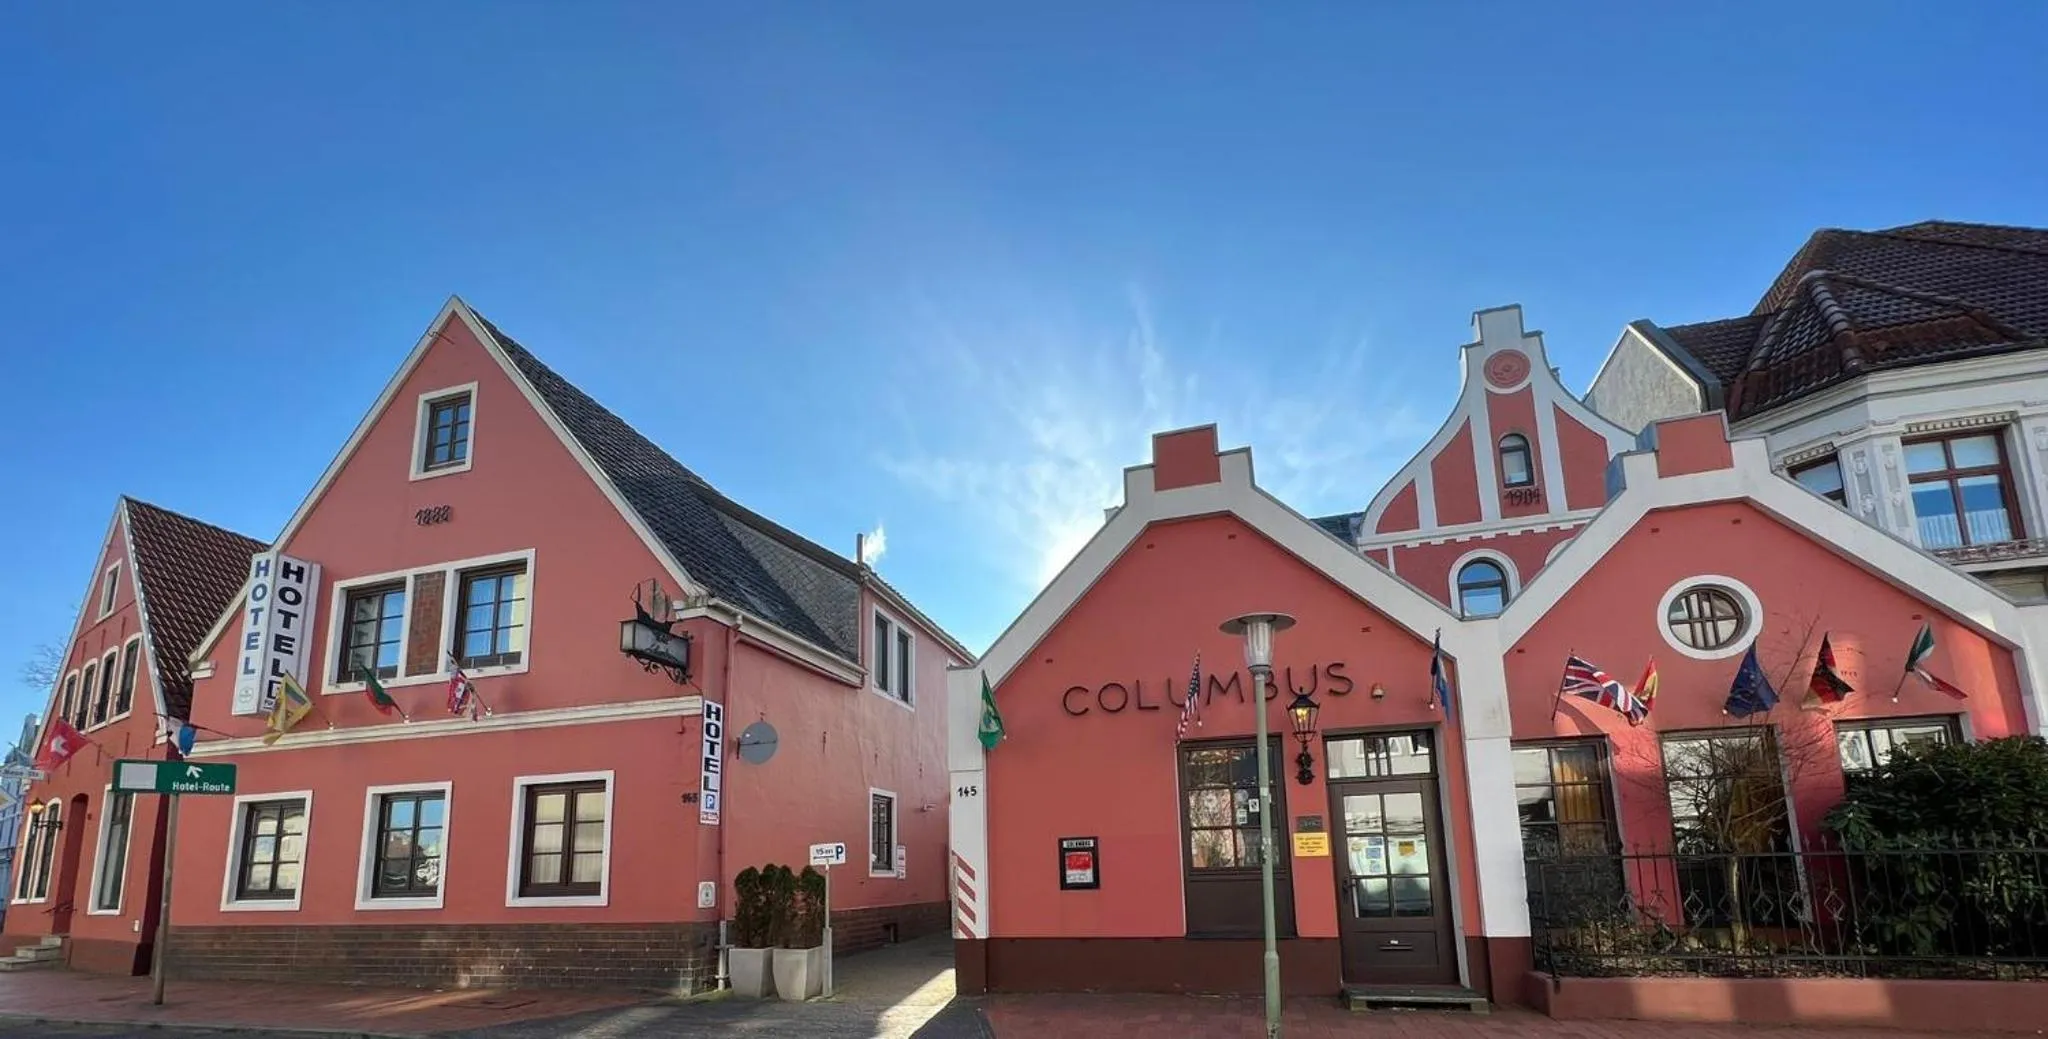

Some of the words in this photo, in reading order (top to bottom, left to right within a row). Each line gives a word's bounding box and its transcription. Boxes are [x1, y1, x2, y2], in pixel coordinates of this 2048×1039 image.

[415, 504, 451, 525] 1888
[243, 559, 271, 676] HOTEL
[271, 560, 305, 678] HOTEL
[702, 703, 721, 793] HOTEL
[172, 781, 230, 792] Hotel-Route
[957, 785, 977, 797] 145
[835, 845, 844, 860] P
